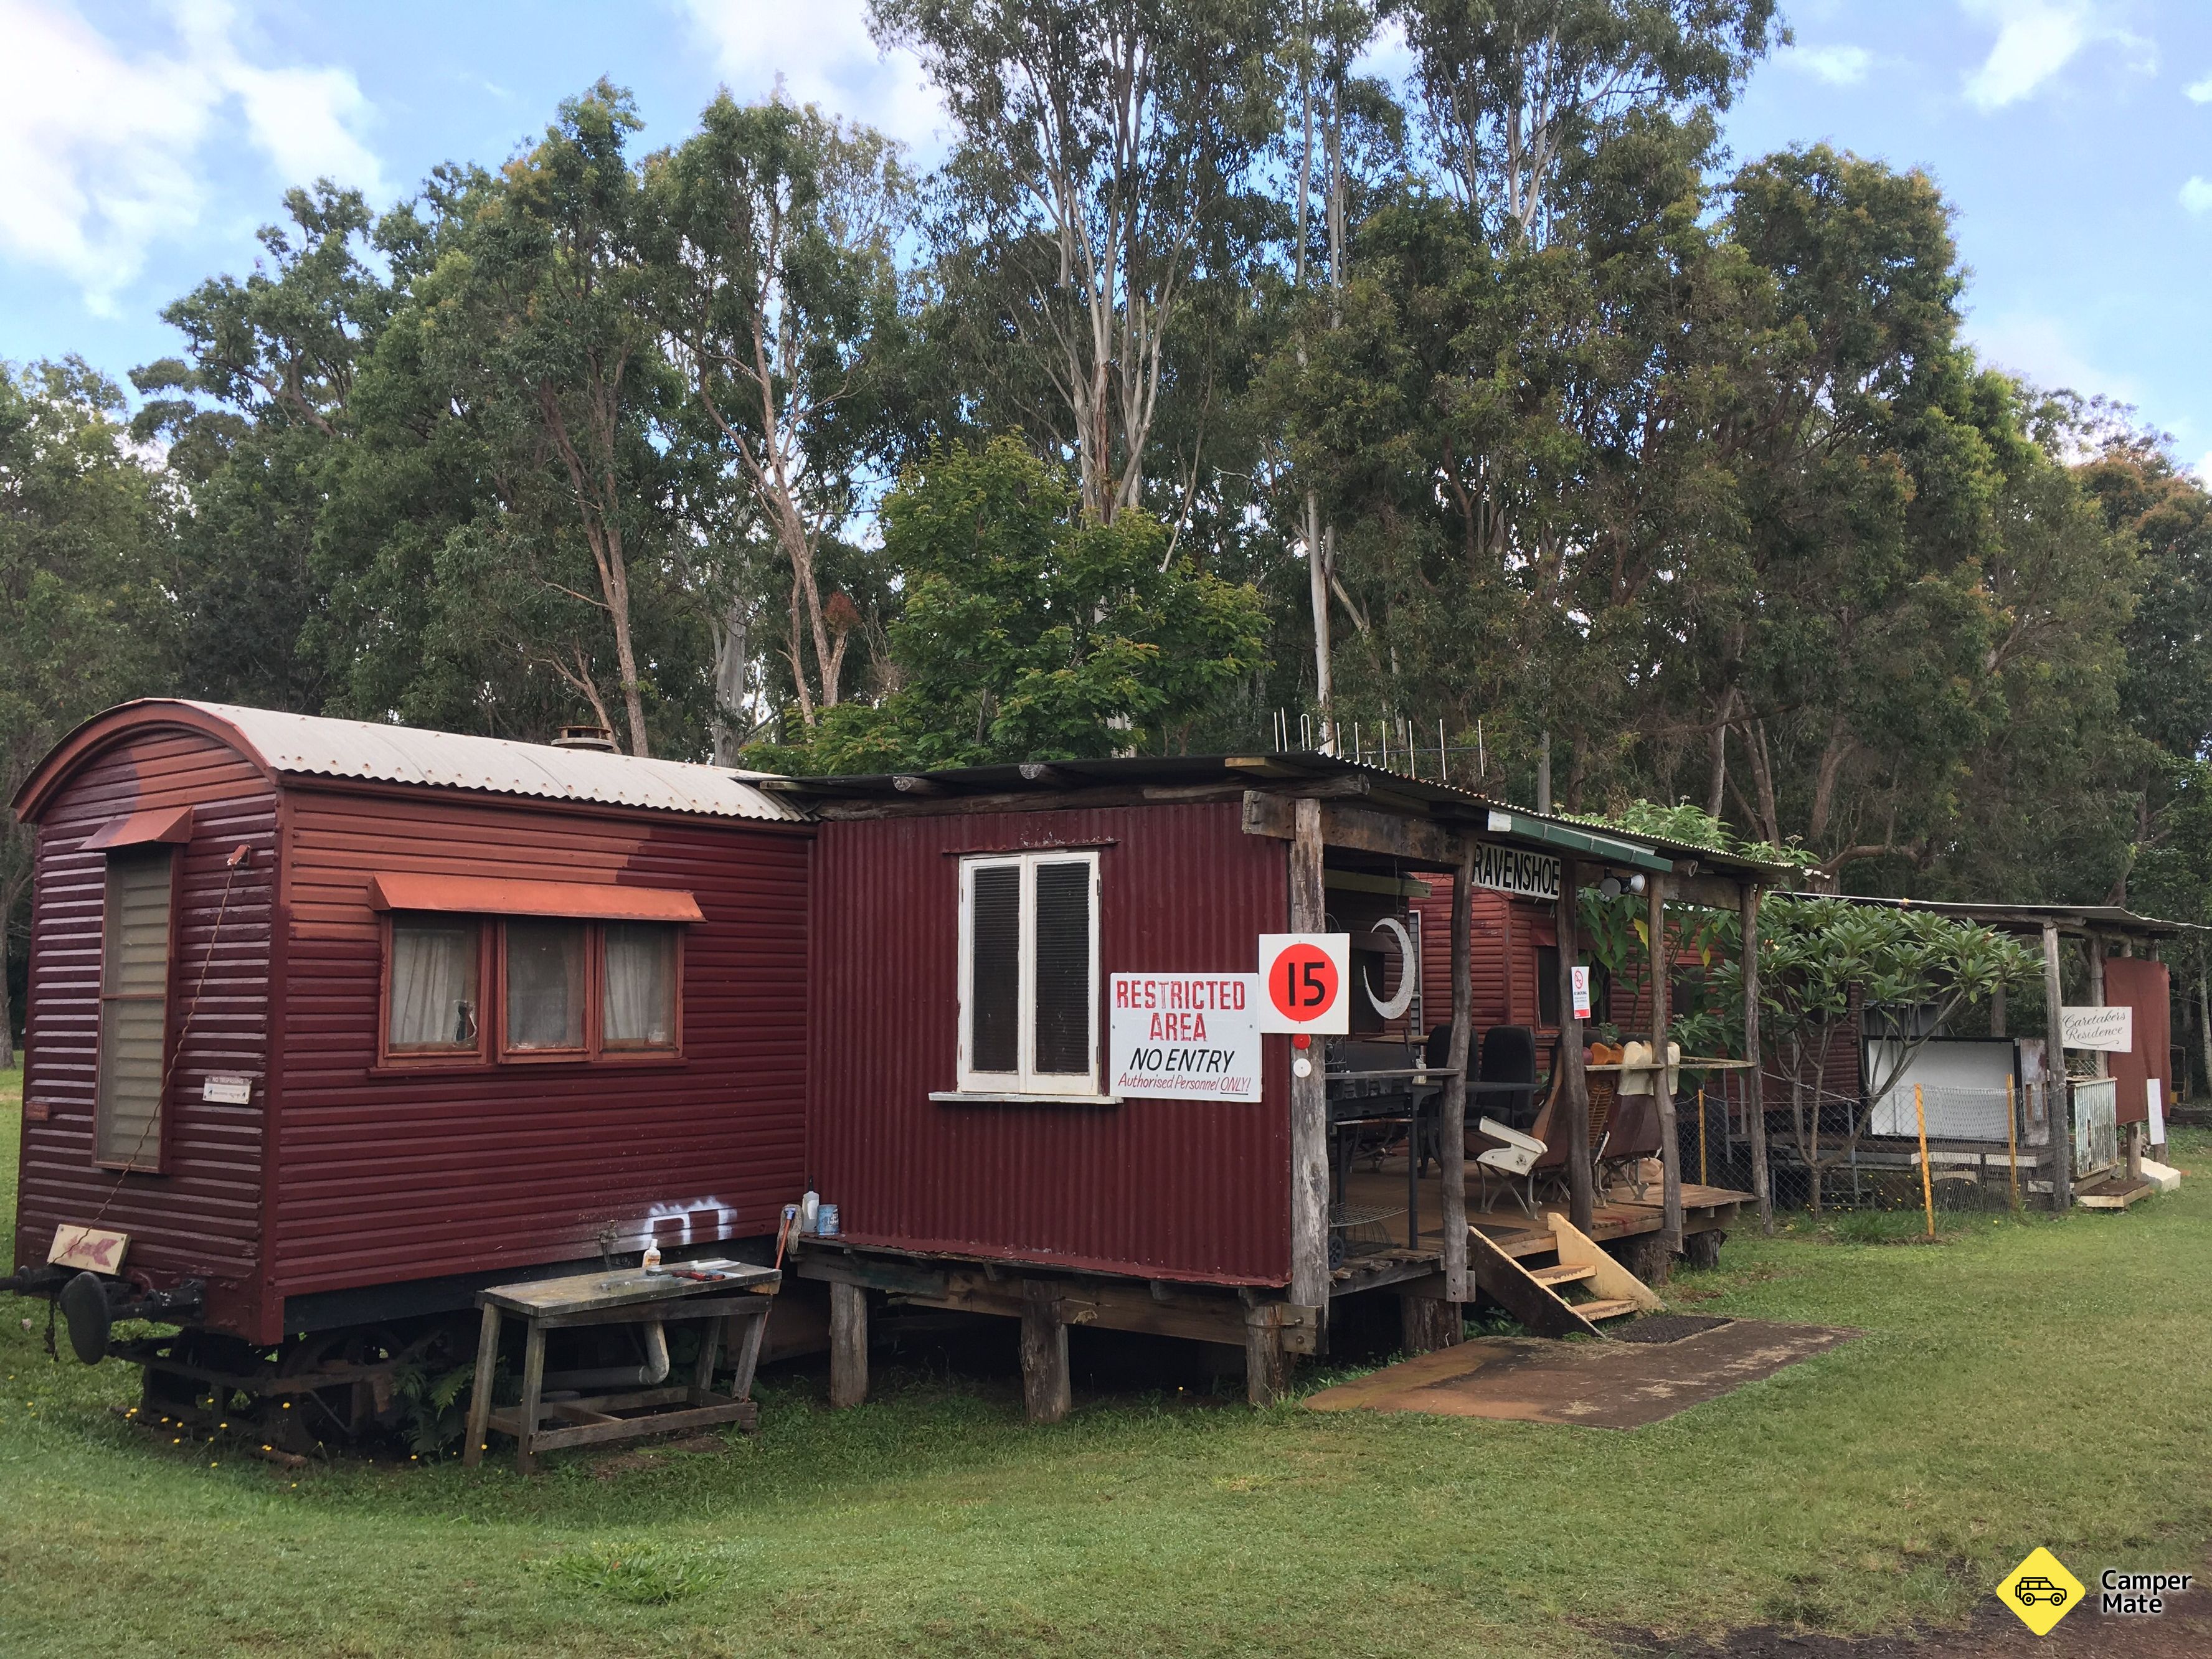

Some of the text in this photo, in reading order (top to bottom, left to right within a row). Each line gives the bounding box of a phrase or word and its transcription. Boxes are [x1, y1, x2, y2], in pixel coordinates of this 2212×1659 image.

[1472, 844, 1559, 896] RAVENSHOE
[1117, 980, 1245, 1010] RESTRICTED
[1288, 961, 1325, 1006] 15
[1150, 1012, 1208, 1042] AREA
[2063, 1009, 2125, 1028] Caretakers
[2064, 1026, 2123, 1046] Residence
[1130, 1047, 1235, 1073] NO ENTRY
[1118, 1072, 1251, 1092] Authorised Personnel ONLY!
